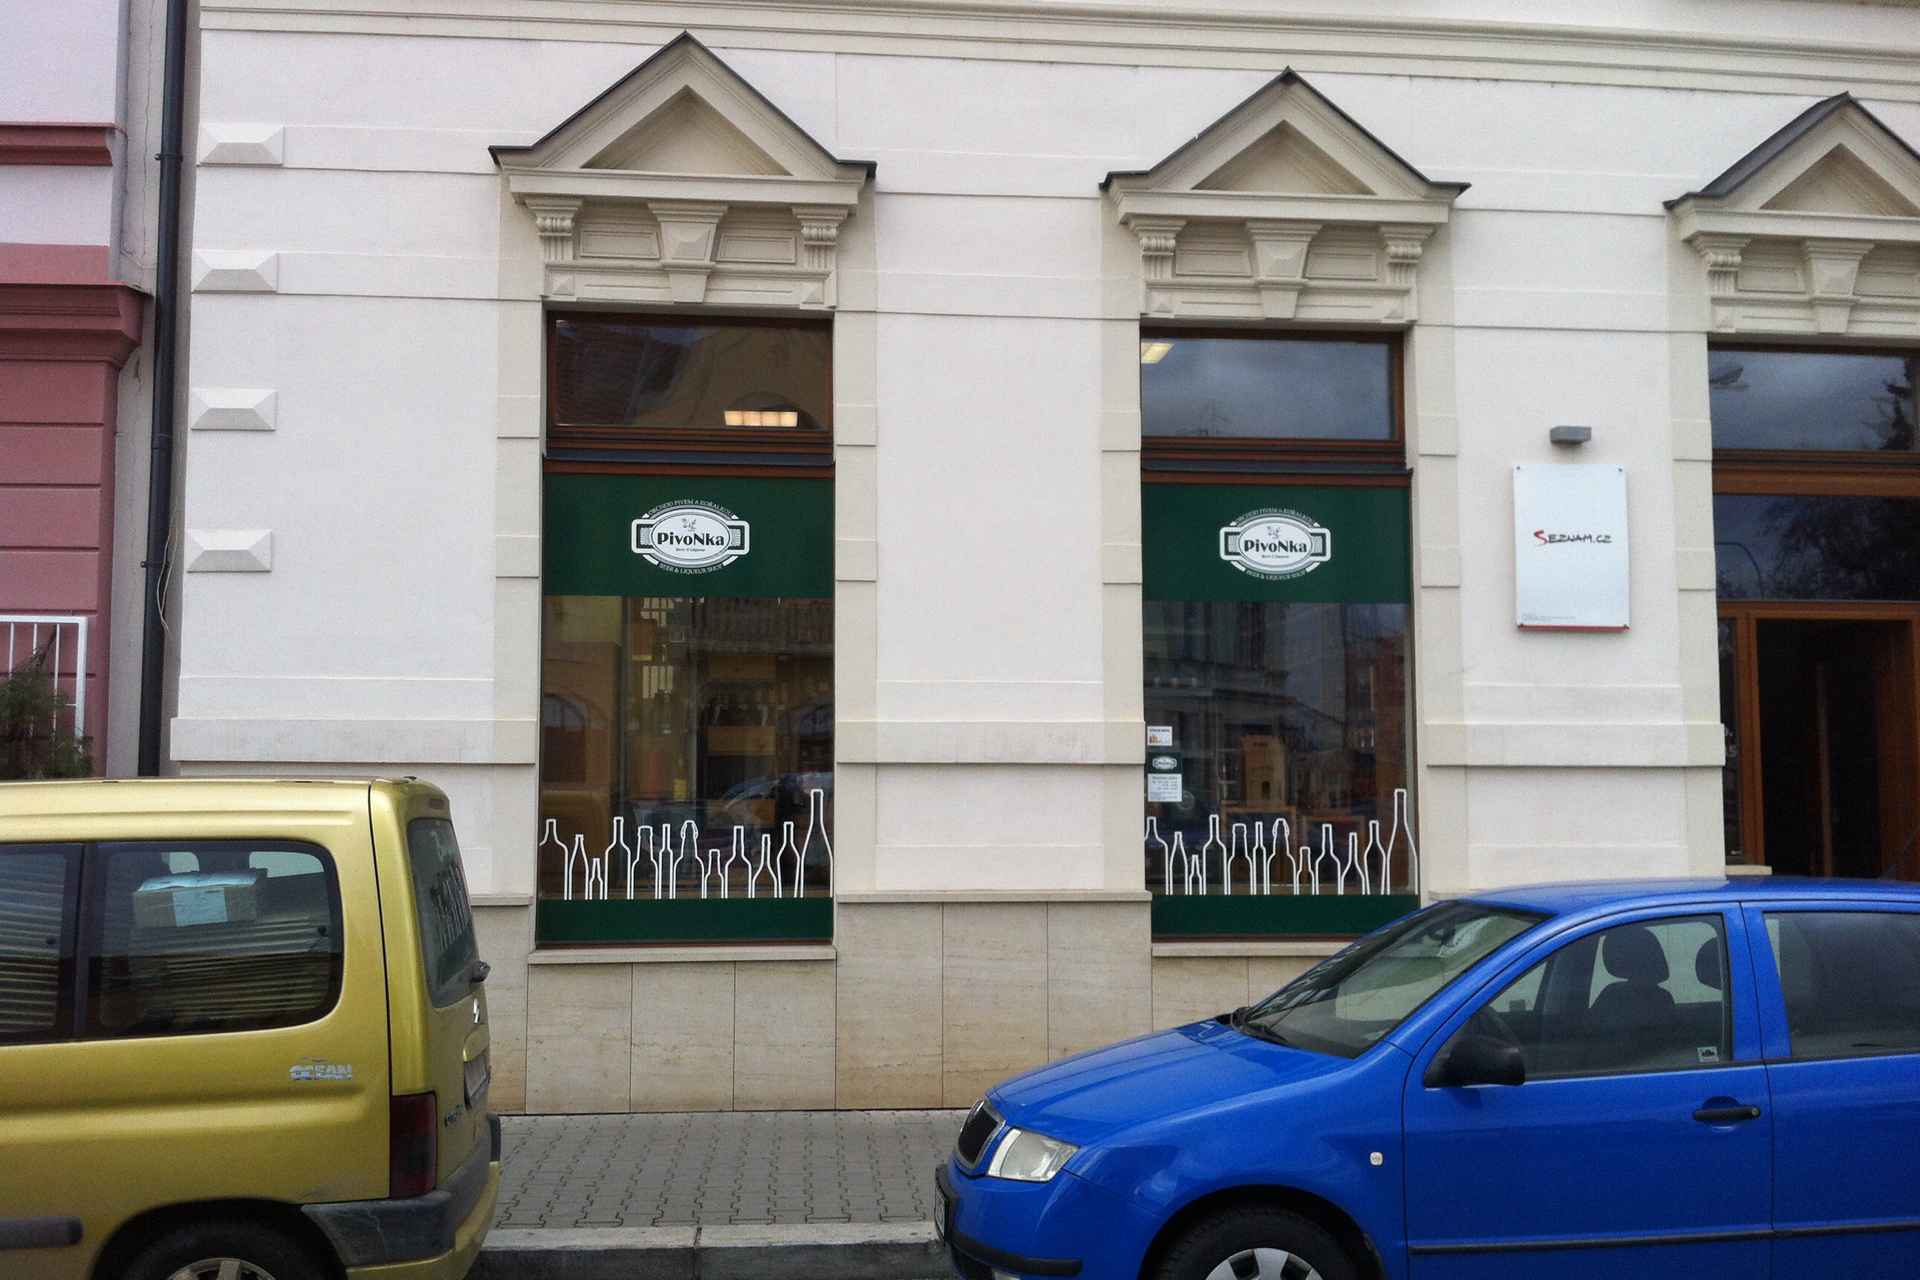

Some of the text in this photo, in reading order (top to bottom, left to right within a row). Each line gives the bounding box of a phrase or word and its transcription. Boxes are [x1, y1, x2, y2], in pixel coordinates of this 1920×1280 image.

[657, 531, 725, 546] PivoNka
[1244, 538, 1307, 553] PivoNka
[289, 1064, 354, 1081] OCEAN
